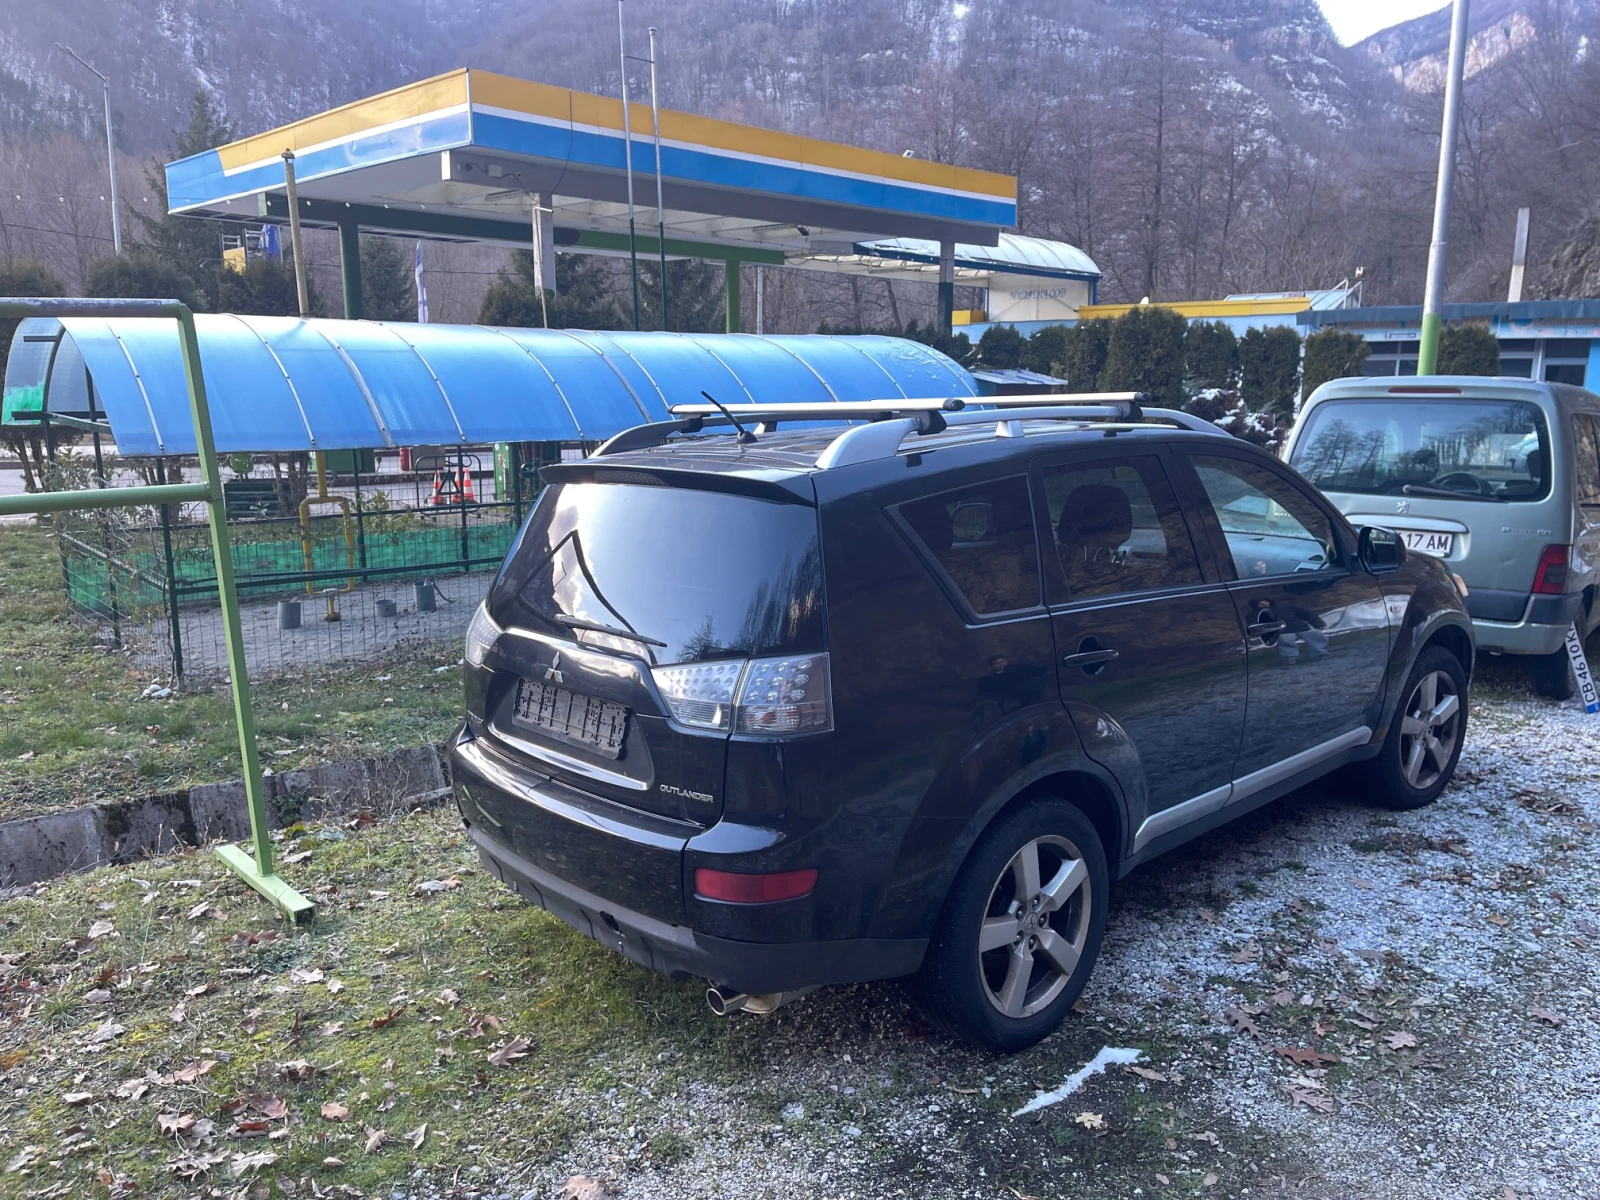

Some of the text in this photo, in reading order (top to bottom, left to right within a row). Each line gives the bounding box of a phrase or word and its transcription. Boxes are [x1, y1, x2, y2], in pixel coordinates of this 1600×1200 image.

[1400, 532, 1449, 551] 17 AM
[1569, 644, 1588, 679] 4610
[660, 784, 714, 803] OUTLANDER
